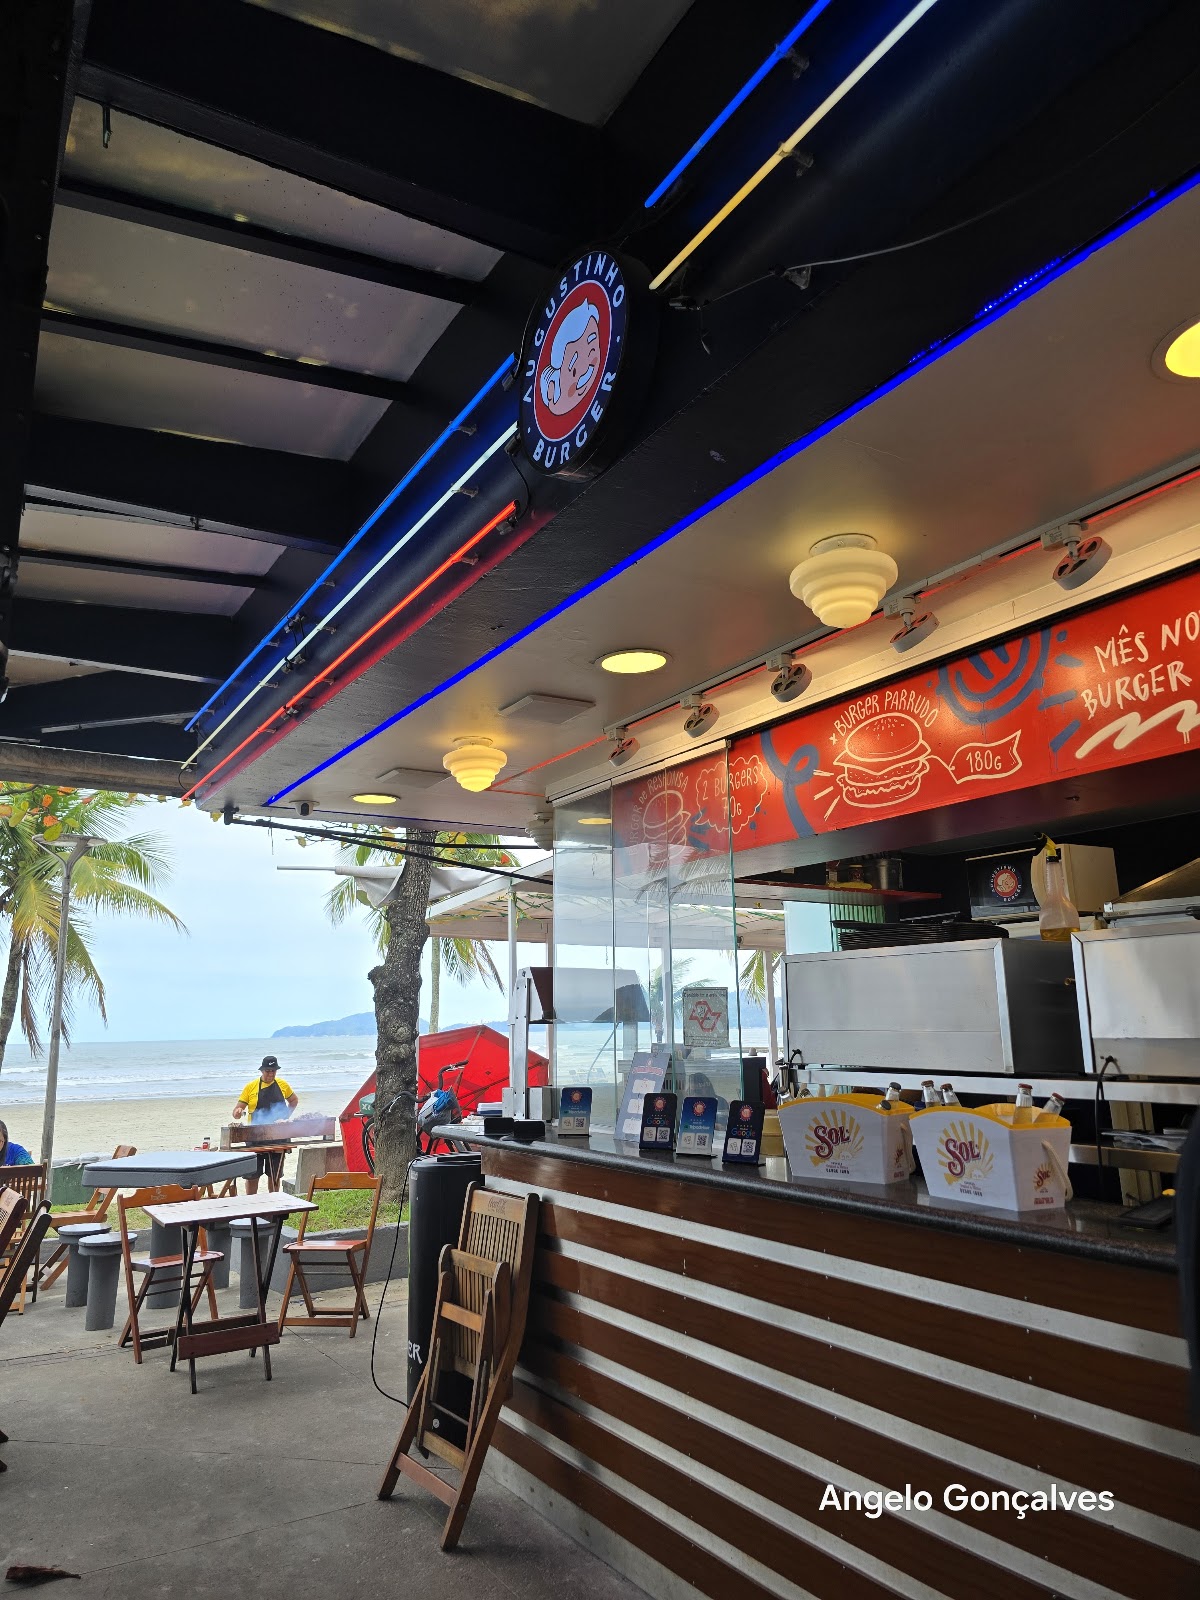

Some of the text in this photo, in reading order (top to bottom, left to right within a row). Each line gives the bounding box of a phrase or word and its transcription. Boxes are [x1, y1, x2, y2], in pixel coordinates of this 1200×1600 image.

[523, 253, 625, 402] AUGUSTINHO
[532, 371, 617, 468] BURGER
[1094, 610, 1200, 673] MÊS NO
[884, 689, 939, 727] PARRUDO
[1081, 661, 1192, 720] BURGER
[702, 780, 709, 800] 2
[731, 1127, 756, 1138] Google
